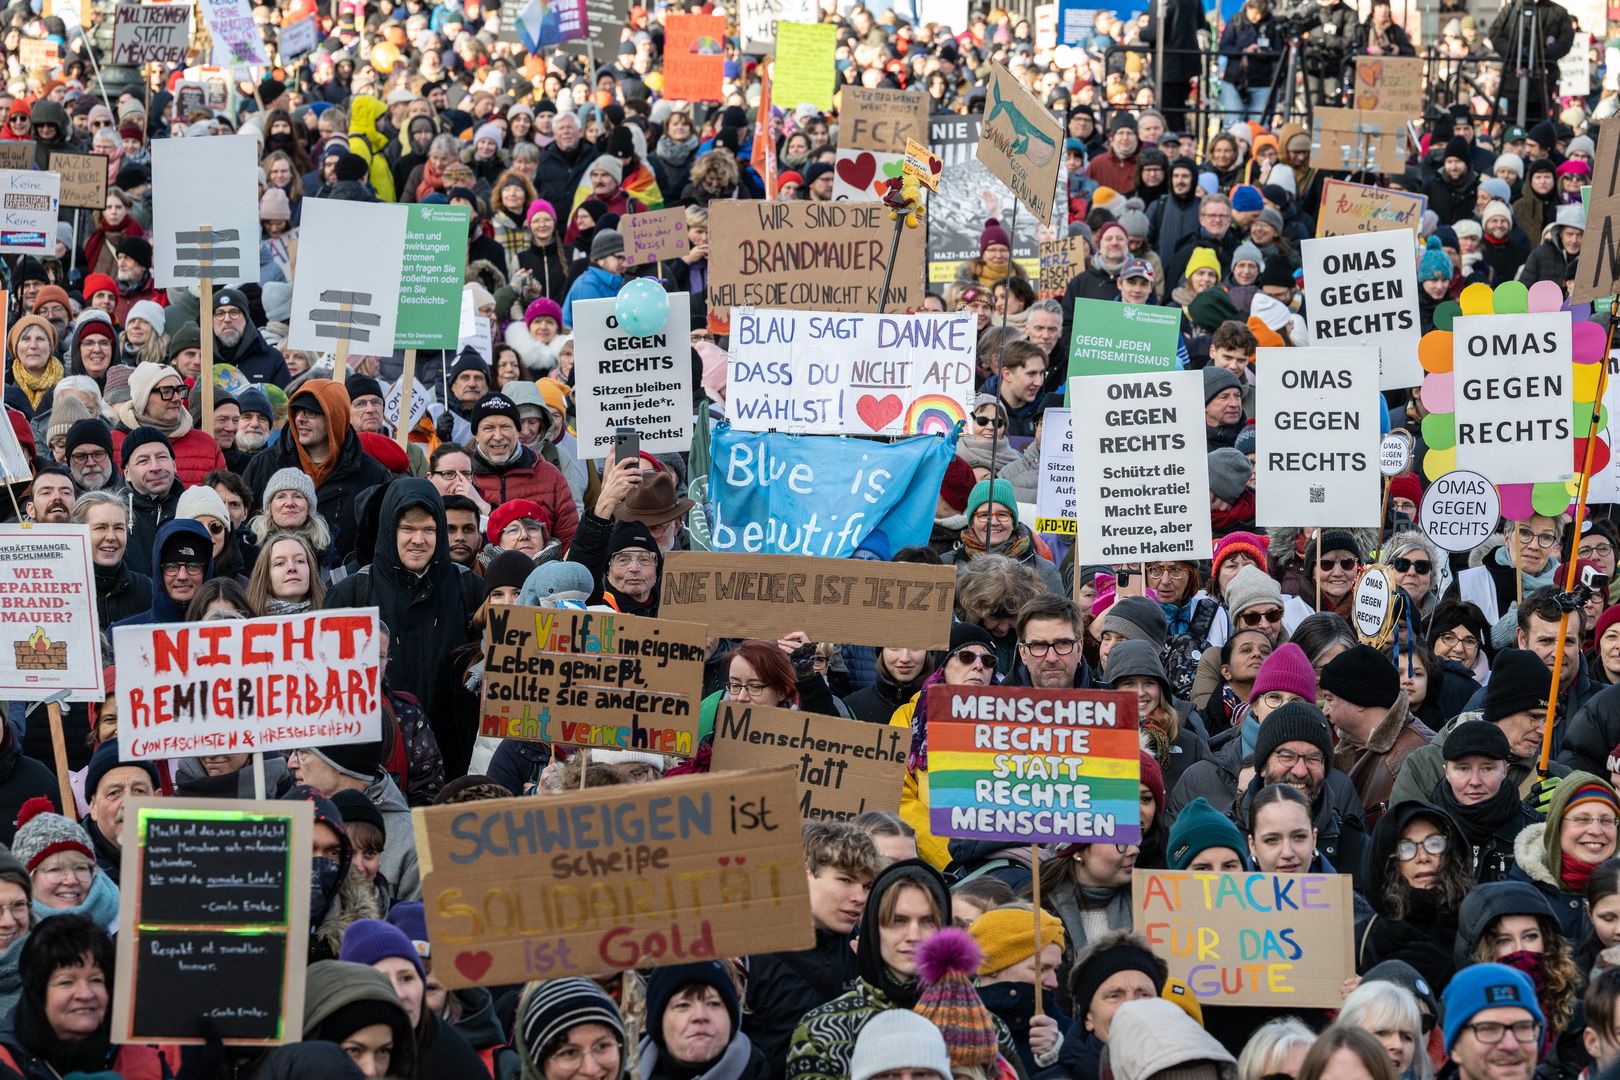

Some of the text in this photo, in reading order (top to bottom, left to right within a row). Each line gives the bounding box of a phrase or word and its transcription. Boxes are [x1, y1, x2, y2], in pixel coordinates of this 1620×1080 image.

[132, 26, 176, 45] STATT
[115, 43, 188, 64] MENSCHEN
[851, 119, 912, 144] FCK
[932, 122, 967, 139] NIE
[55, 155, 92, 170] NAZIS
[11, 174, 44, 190] Keine
[1360, 187, 1389, 200] Lieber
[5, 212, 37, 227] Keine
[758, 203, 881, 229] WIR SIND DIE
[1358, 220, 1377, 232] als
[426, 231, 442, 241] und
[403, 242, 450, 254] nwirkungen
[1040, 237, 1076, 256] FRITZE
[738, 240, 887, 275] BRANDMAUER
[1040, 252, 1070, 268] MERZ
[1322, 248, 1396, 275] OMAS
[416, 264, 456, 275] fragen Sie
[440, 275, 460, 284] oder
[414, 285, 427, 294] Sie
[709, 282, 860, 306] WEIL ES DIE CDU NICHT
[1320, 279, 1403, 307] GEGEN
[400, 296, 448, 305] Geschichts-
[739, 316, 972, 354] BLAU SAGT DANKE,
[1316, 310, 1413, 340] RECHTS
[604, 334, 667, 352] GEGEN
[1076, 335, 1152, 352] GEGEN JEDEN
[1467, 332, 1558, 358] OMAS
[598, 356, 674, 375] RECHTS
[1074, 347, 1170, 367] ANTISEMITISMUS
[734, 360, 972, 392] DASS DU NICHT AfD
[1281, 370, 1354, 390] OMAS
[592, 380, 682, 397] Sitzen bleiben
[1106, 381, 1173, 400] OMAS
[1463, 375, 1563, 401] GEGEN
[600, 400, 631, 412] kann
[605, 413, 672, 428] Aufstehen
[1105, 407, 1177, 427] GEGEN
[1274, 411, 1360, 431] GEGEN
[1459, 418, 1569, 445] RECHTS
[1100, 433, 1186, 454] RECHTS
[1103, 464, 1186, 479] Schützt die
[1269, 453, 1367, 472] RECHTS
[726, 442, 892, 504] Blue is
[1100, 482, 1190, 499] Demokratie!
[1438, 480, 1485, 495] OMAS
[1104, 503, 1188, 518] Macht Eure
[1432, 501, 1487, 516] GEGEN
[1101, 521, 1193, 538] Kreuze, aber
[1429, 521, 1489, 536] RECHTS
[0, 543, 71, 553] HKRÄFTEMANGEL
[1102, 539, 1194, 556] ohne Haken!!
[13, 568, 54, 579] WER
[1365, 577, 1383, 590] OMAS
[0, 582, 82, 594] EPARIERT
[663, 571, 955, 612] NIE WIEDER IST JETZT
[2, 597, 70, 608] BRAND-
[1361, 595, 1382, 608] GEGEN
[1, 612, 73, 624] MAUER?
[1357, 611, 1381, 626] RECHTS
[488, 607, 532, 648] Wer
[534, 611, 615, 654] Vielfalt
[152, 616, 374, 677] NICHT
[485, 649, 648, 689] Leben genießt,
[129, 665, 379, 729] REMIGRIERBAR!
[488, 676, 690, 716] sollte sie anderen
[951, 695, 1116, 727] MENSCHEN
[482, 705, 693, 753] nicht verwehren
[720, 705, 907, 763] Menschenrechte
[974, 724, 1090, 754] RECHTE
[163, 731, 238, 753] FASCHISTEN
[243, 731, 255, 747] &
[795, 753, 848, 789] tatt
[992, 753, 1083, 782] STATT
[975, 780, 1091, 810] RECHTE
[449, 792, 779, 864] SCHWEIGEN ist
[951, 805, 1116, 838] MENSCHEN
[551, 845, 670, 880] scheiße
[438, 856, 797, 944] SOLIDARITÄT
[1143, 875, 1330, 913] ATTACKE
[523, 920, 717, 974] ist Gold
[1147, 919, 1303, 962] FÜR DAS
[1187, 964, 1295, 998] GUTE
